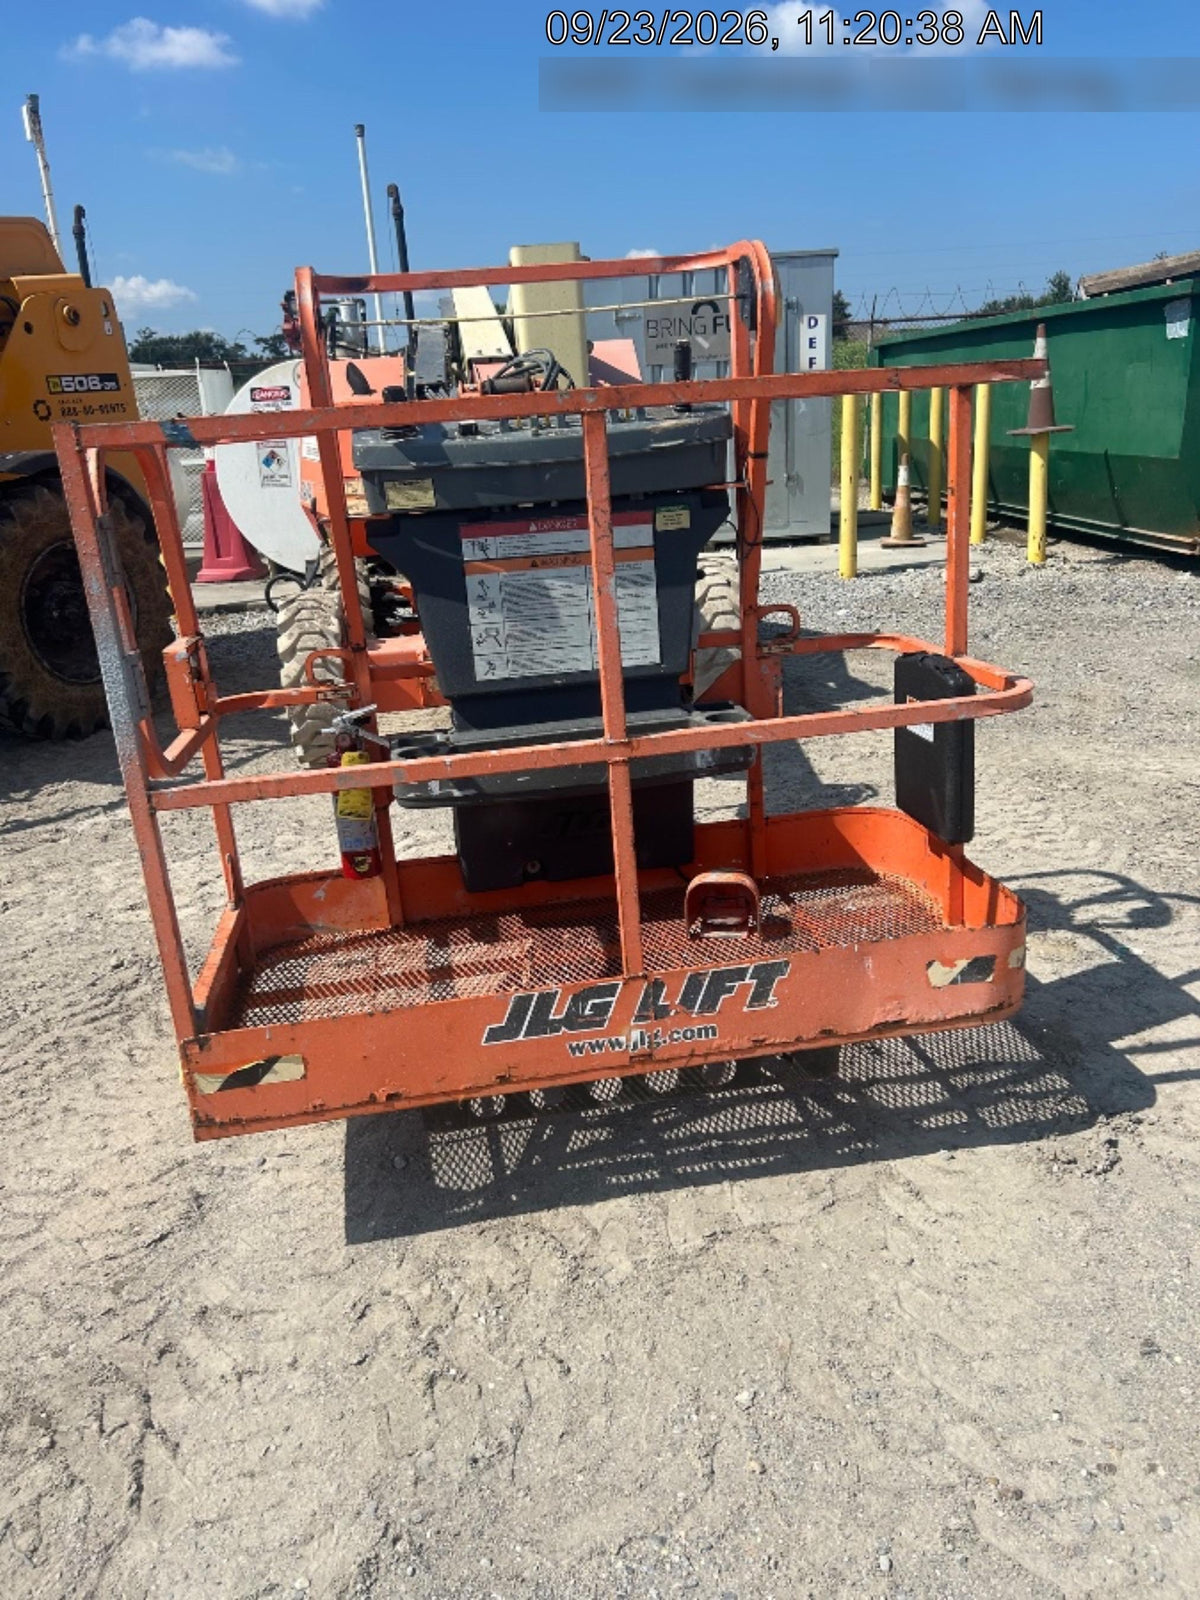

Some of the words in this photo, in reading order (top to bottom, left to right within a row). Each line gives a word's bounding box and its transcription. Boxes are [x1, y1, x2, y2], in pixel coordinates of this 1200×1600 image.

[647, 316, 706, 339] BRING
[482, 981, 623, 1045] JLG
[631, 959, 791, 1024] LIFT
[568, 1024, 719, 1057] www.jlg.com
